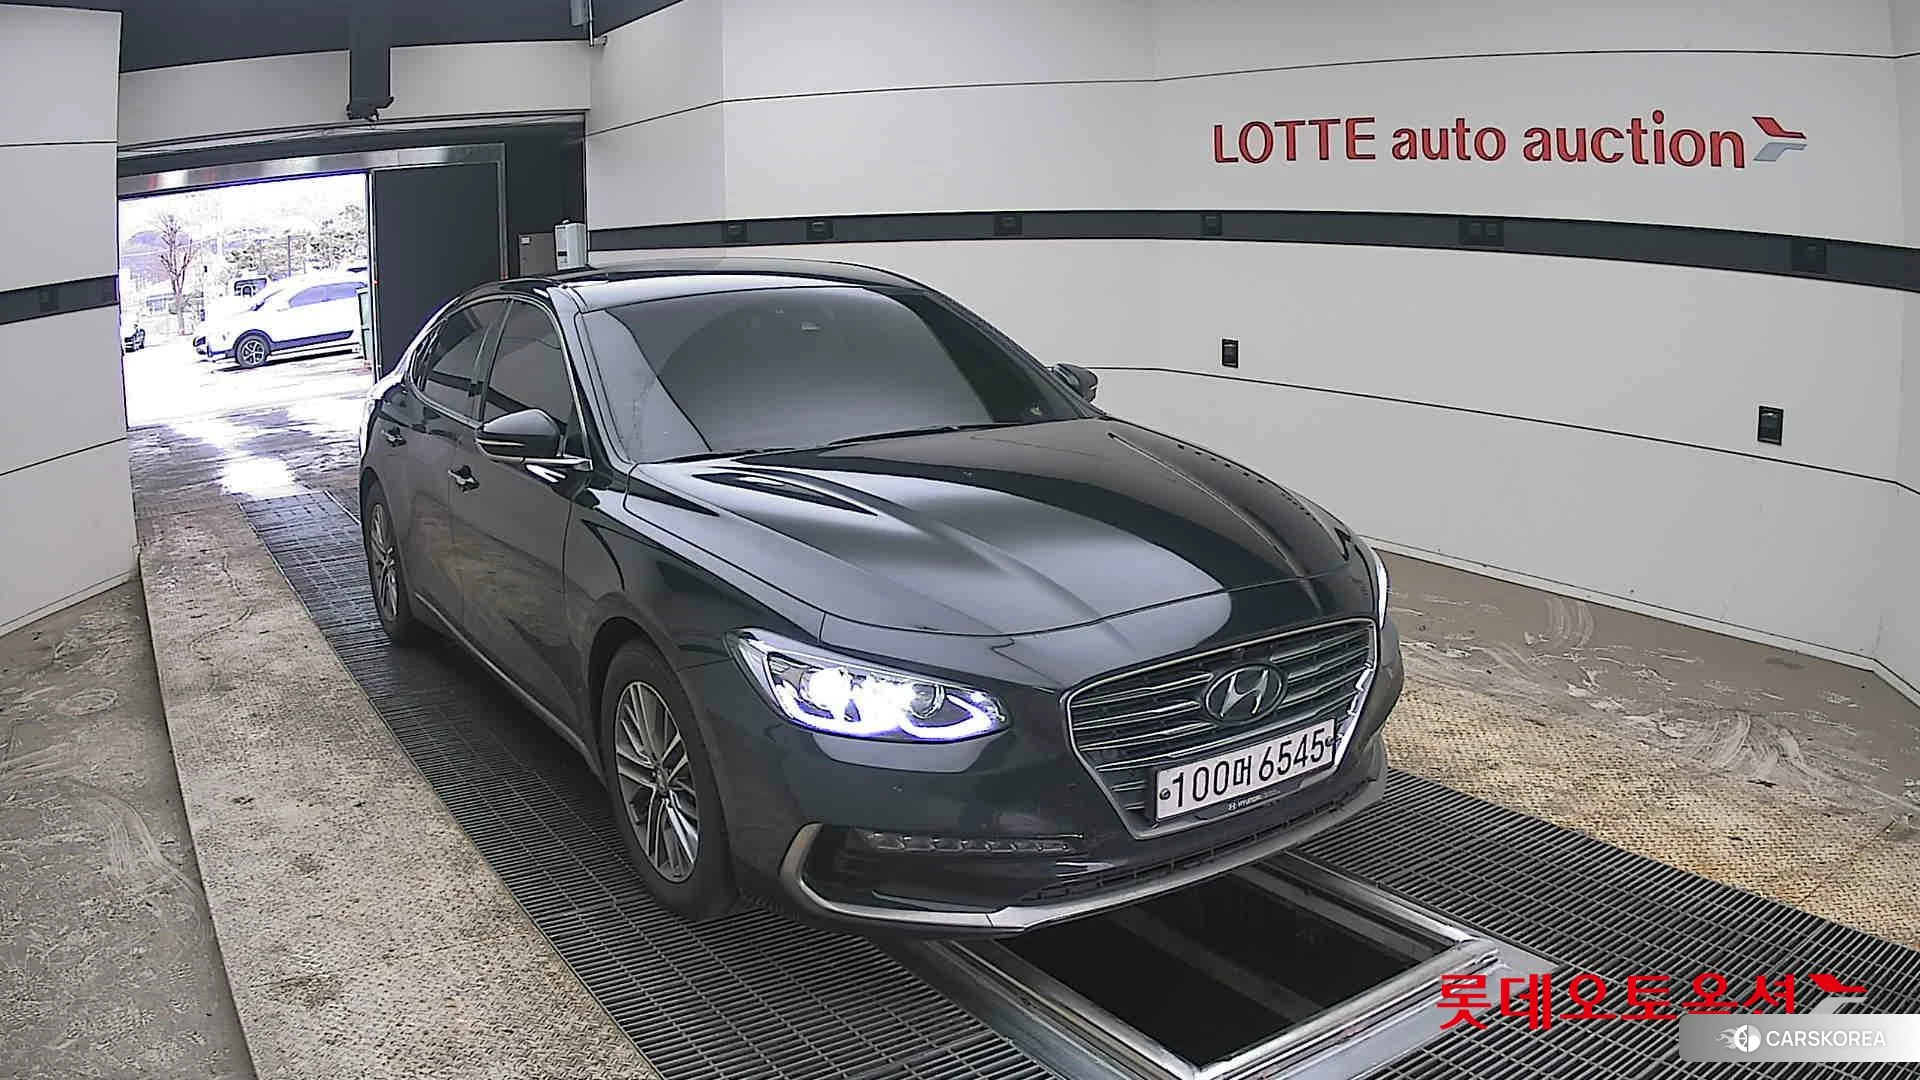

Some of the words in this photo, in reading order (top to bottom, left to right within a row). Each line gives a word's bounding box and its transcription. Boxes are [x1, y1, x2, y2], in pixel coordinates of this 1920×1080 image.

[1212, 117, 1376, 164] LOTTE
[1391, 118, 1507, 162] auto
[1522, 110, 1745, 169] auction
[1172, 754, 1252, 808] 100머
[1258, 728, 1326, 782] 6545
